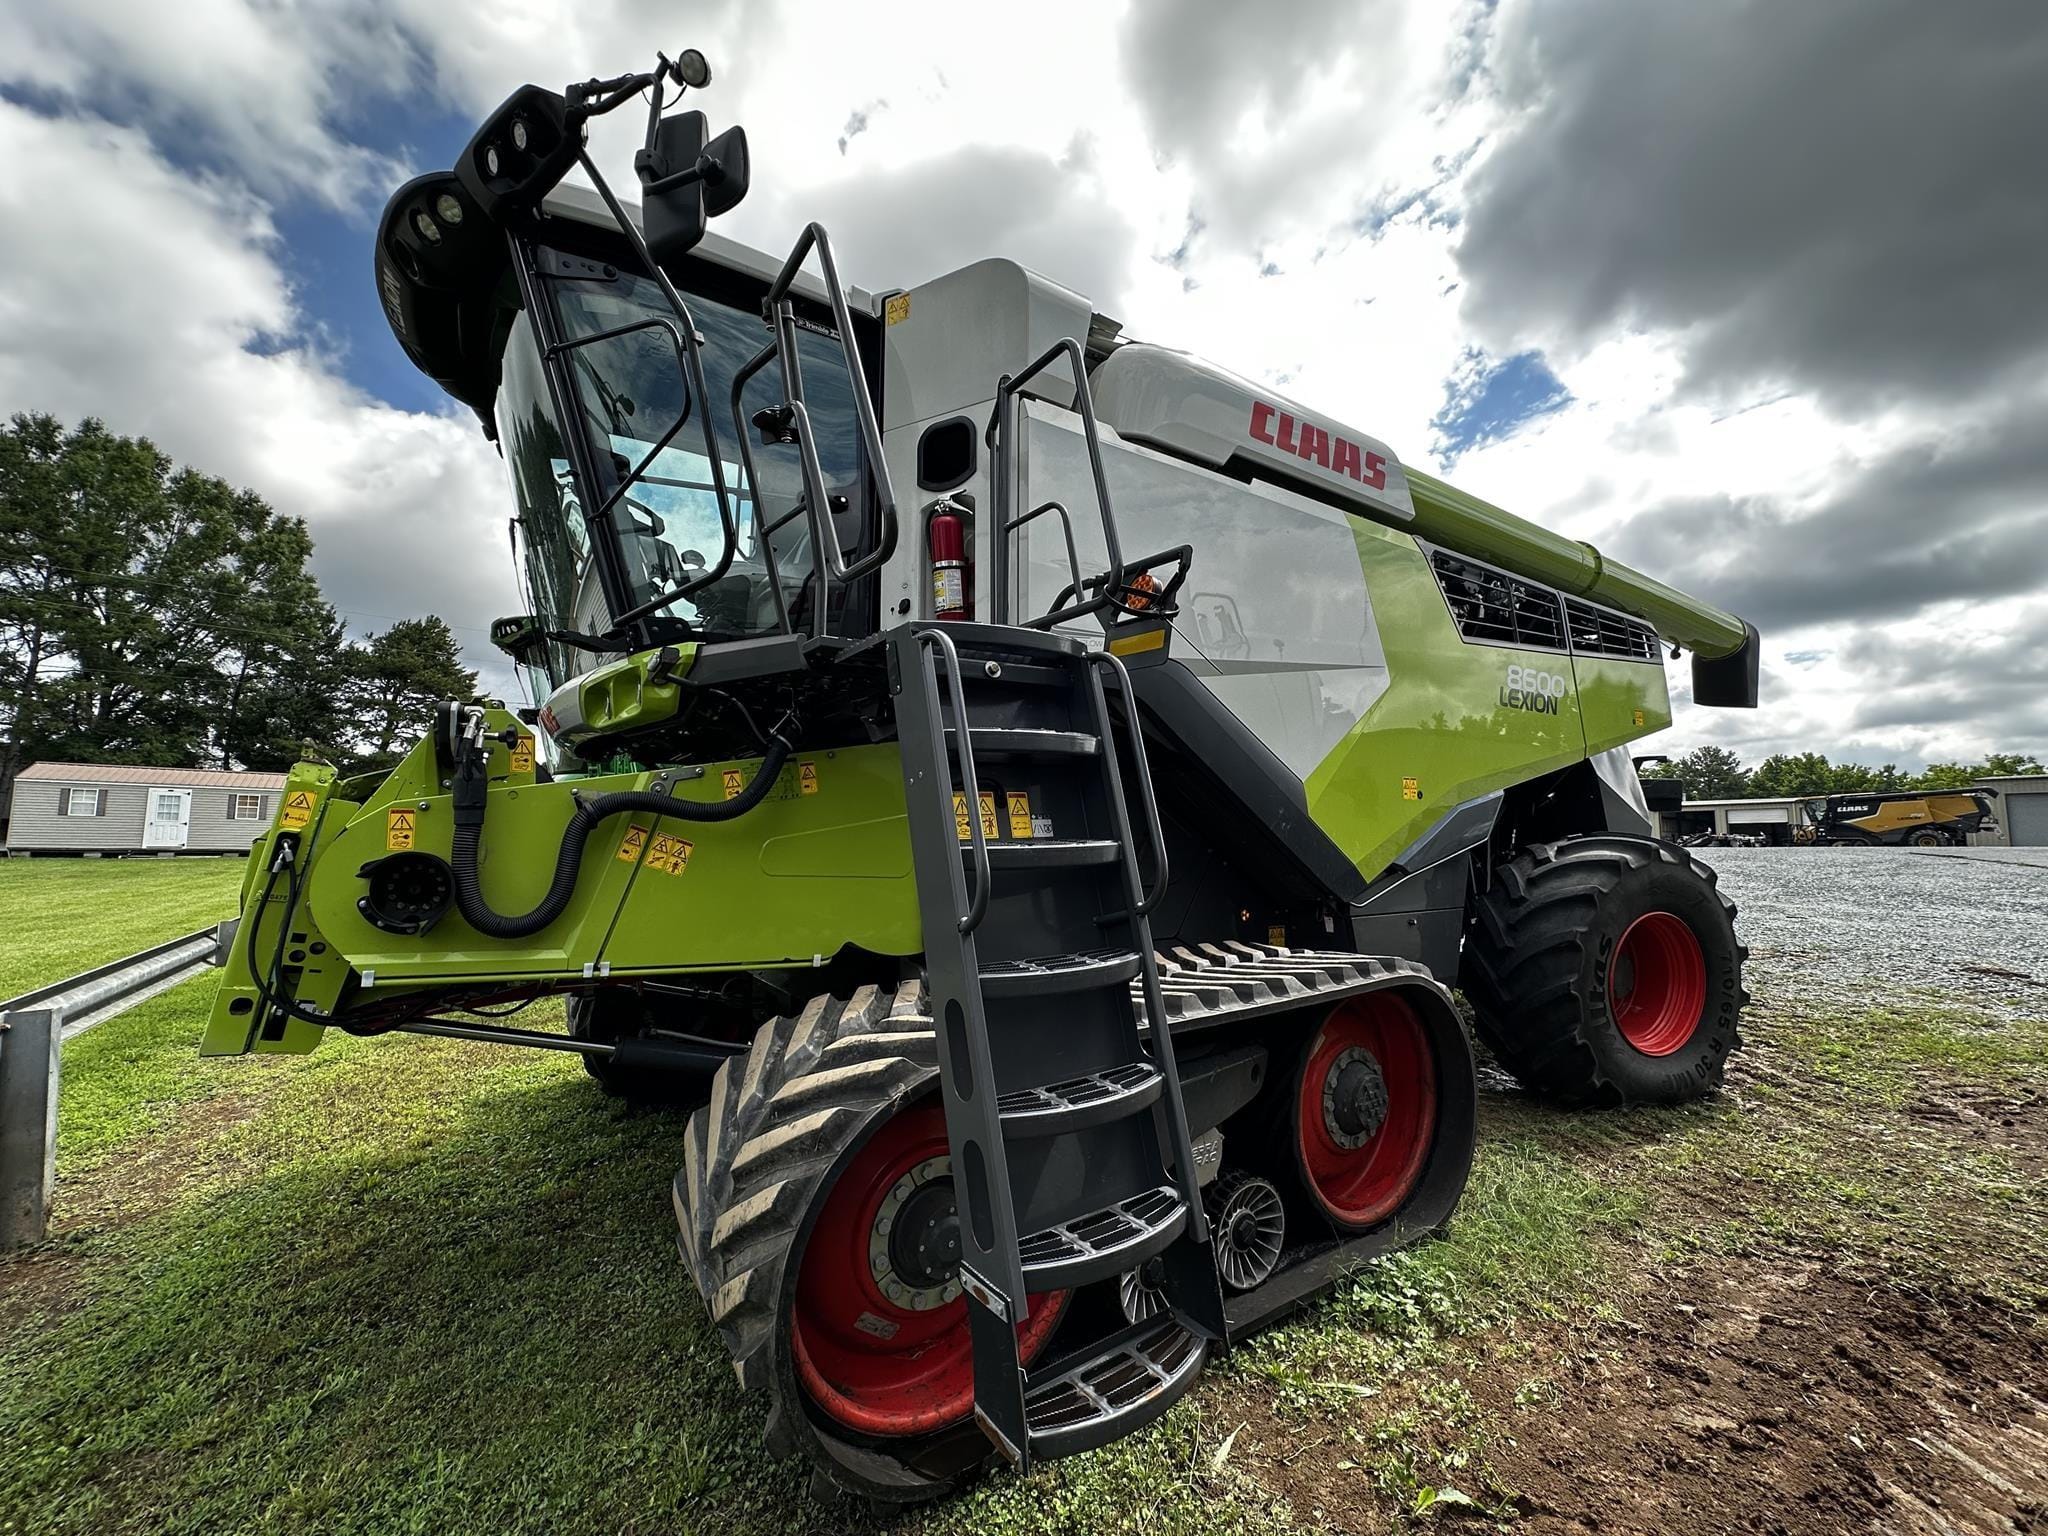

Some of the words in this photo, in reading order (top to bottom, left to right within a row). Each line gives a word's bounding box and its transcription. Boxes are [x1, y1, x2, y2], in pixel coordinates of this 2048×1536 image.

[1249, 401, 1386, 491] CLAAS
[1507, 664, 1565, 698] 8600
[1499, 686, 1558, 716] LEXION
[1837, 805, 1869, 813] CLAAS
[1719, 950, 1735, 1030] 710/65
[1709, 1036, 1723, 1055] R
[1695, 1055, 1713, 1079] 30
[1191, 1140, 1218, 1157] ERRA
[1193, 1151, 1217, 1165] RAC
